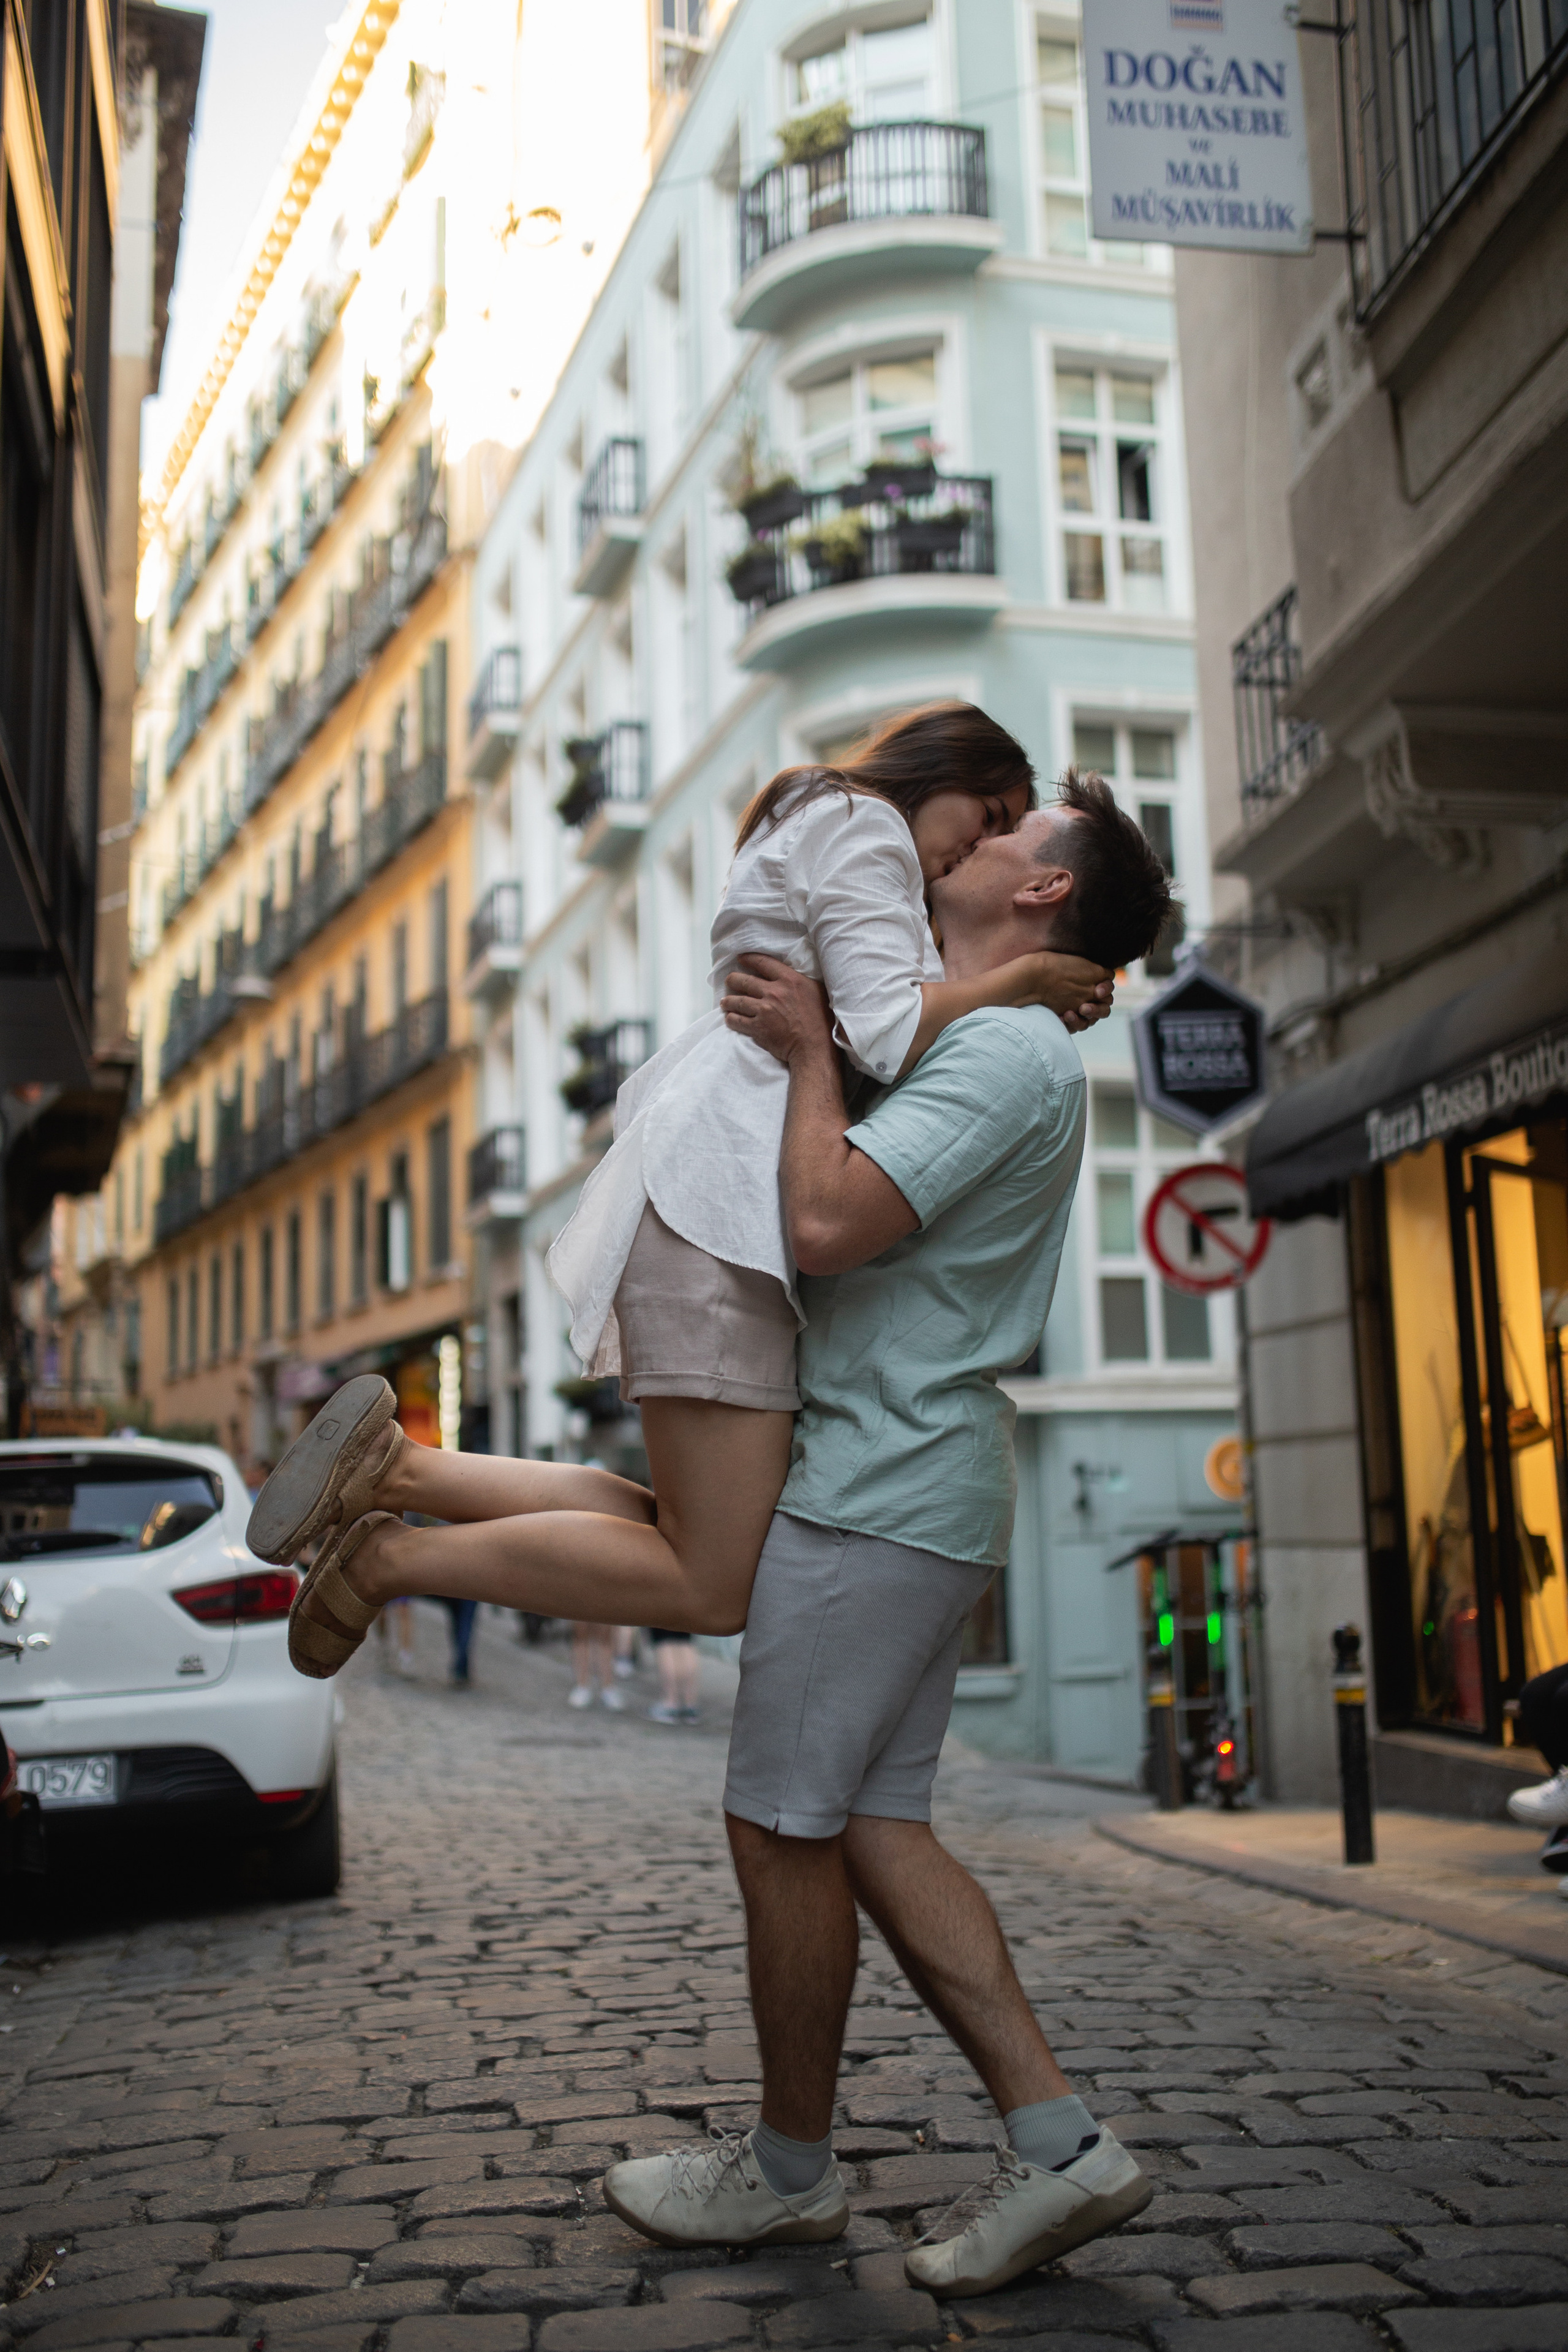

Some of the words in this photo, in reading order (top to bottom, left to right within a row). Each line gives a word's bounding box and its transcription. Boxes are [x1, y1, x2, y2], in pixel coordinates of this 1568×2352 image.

[1104, 44, 1286, 99] DOĞAN
[1106, 98, 1292, 138] MUHASEBE
[1166, 157, 1239, 191] MALİ
[1111, 187, 1296, 233] MÜŞAVİRLİK
[1365, 1104, 1420, 1162] Terra
[1422, 1082, 1487, 1138] Rossa
[28, 1761, 111, 1796] 0579
